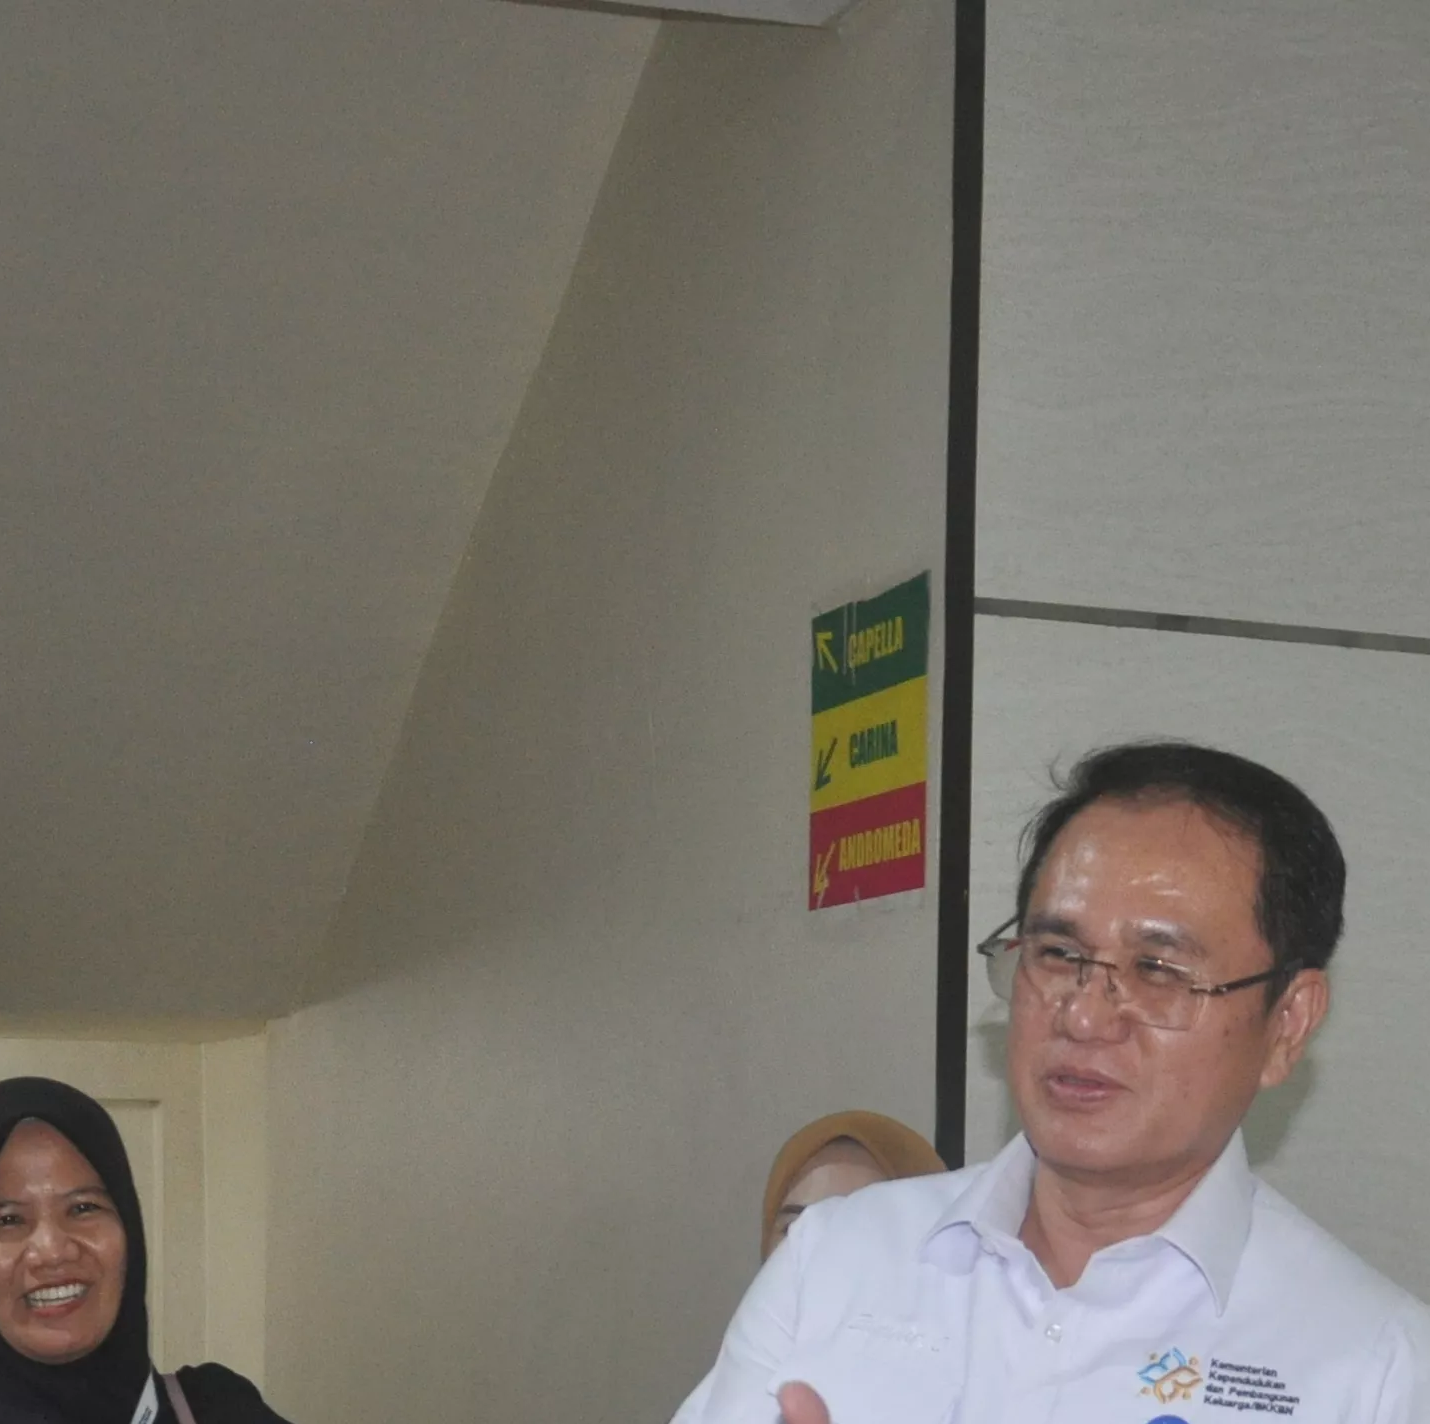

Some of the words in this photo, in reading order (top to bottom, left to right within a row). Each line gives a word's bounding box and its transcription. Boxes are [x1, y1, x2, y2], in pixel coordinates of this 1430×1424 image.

[848, 615, 903, 669] CAPELLA
[850, 719, 898, 768] CARINA
[838, 817, 921, 872] ANDROMEDA
[1205, 1383, 1224, 1394] dan
